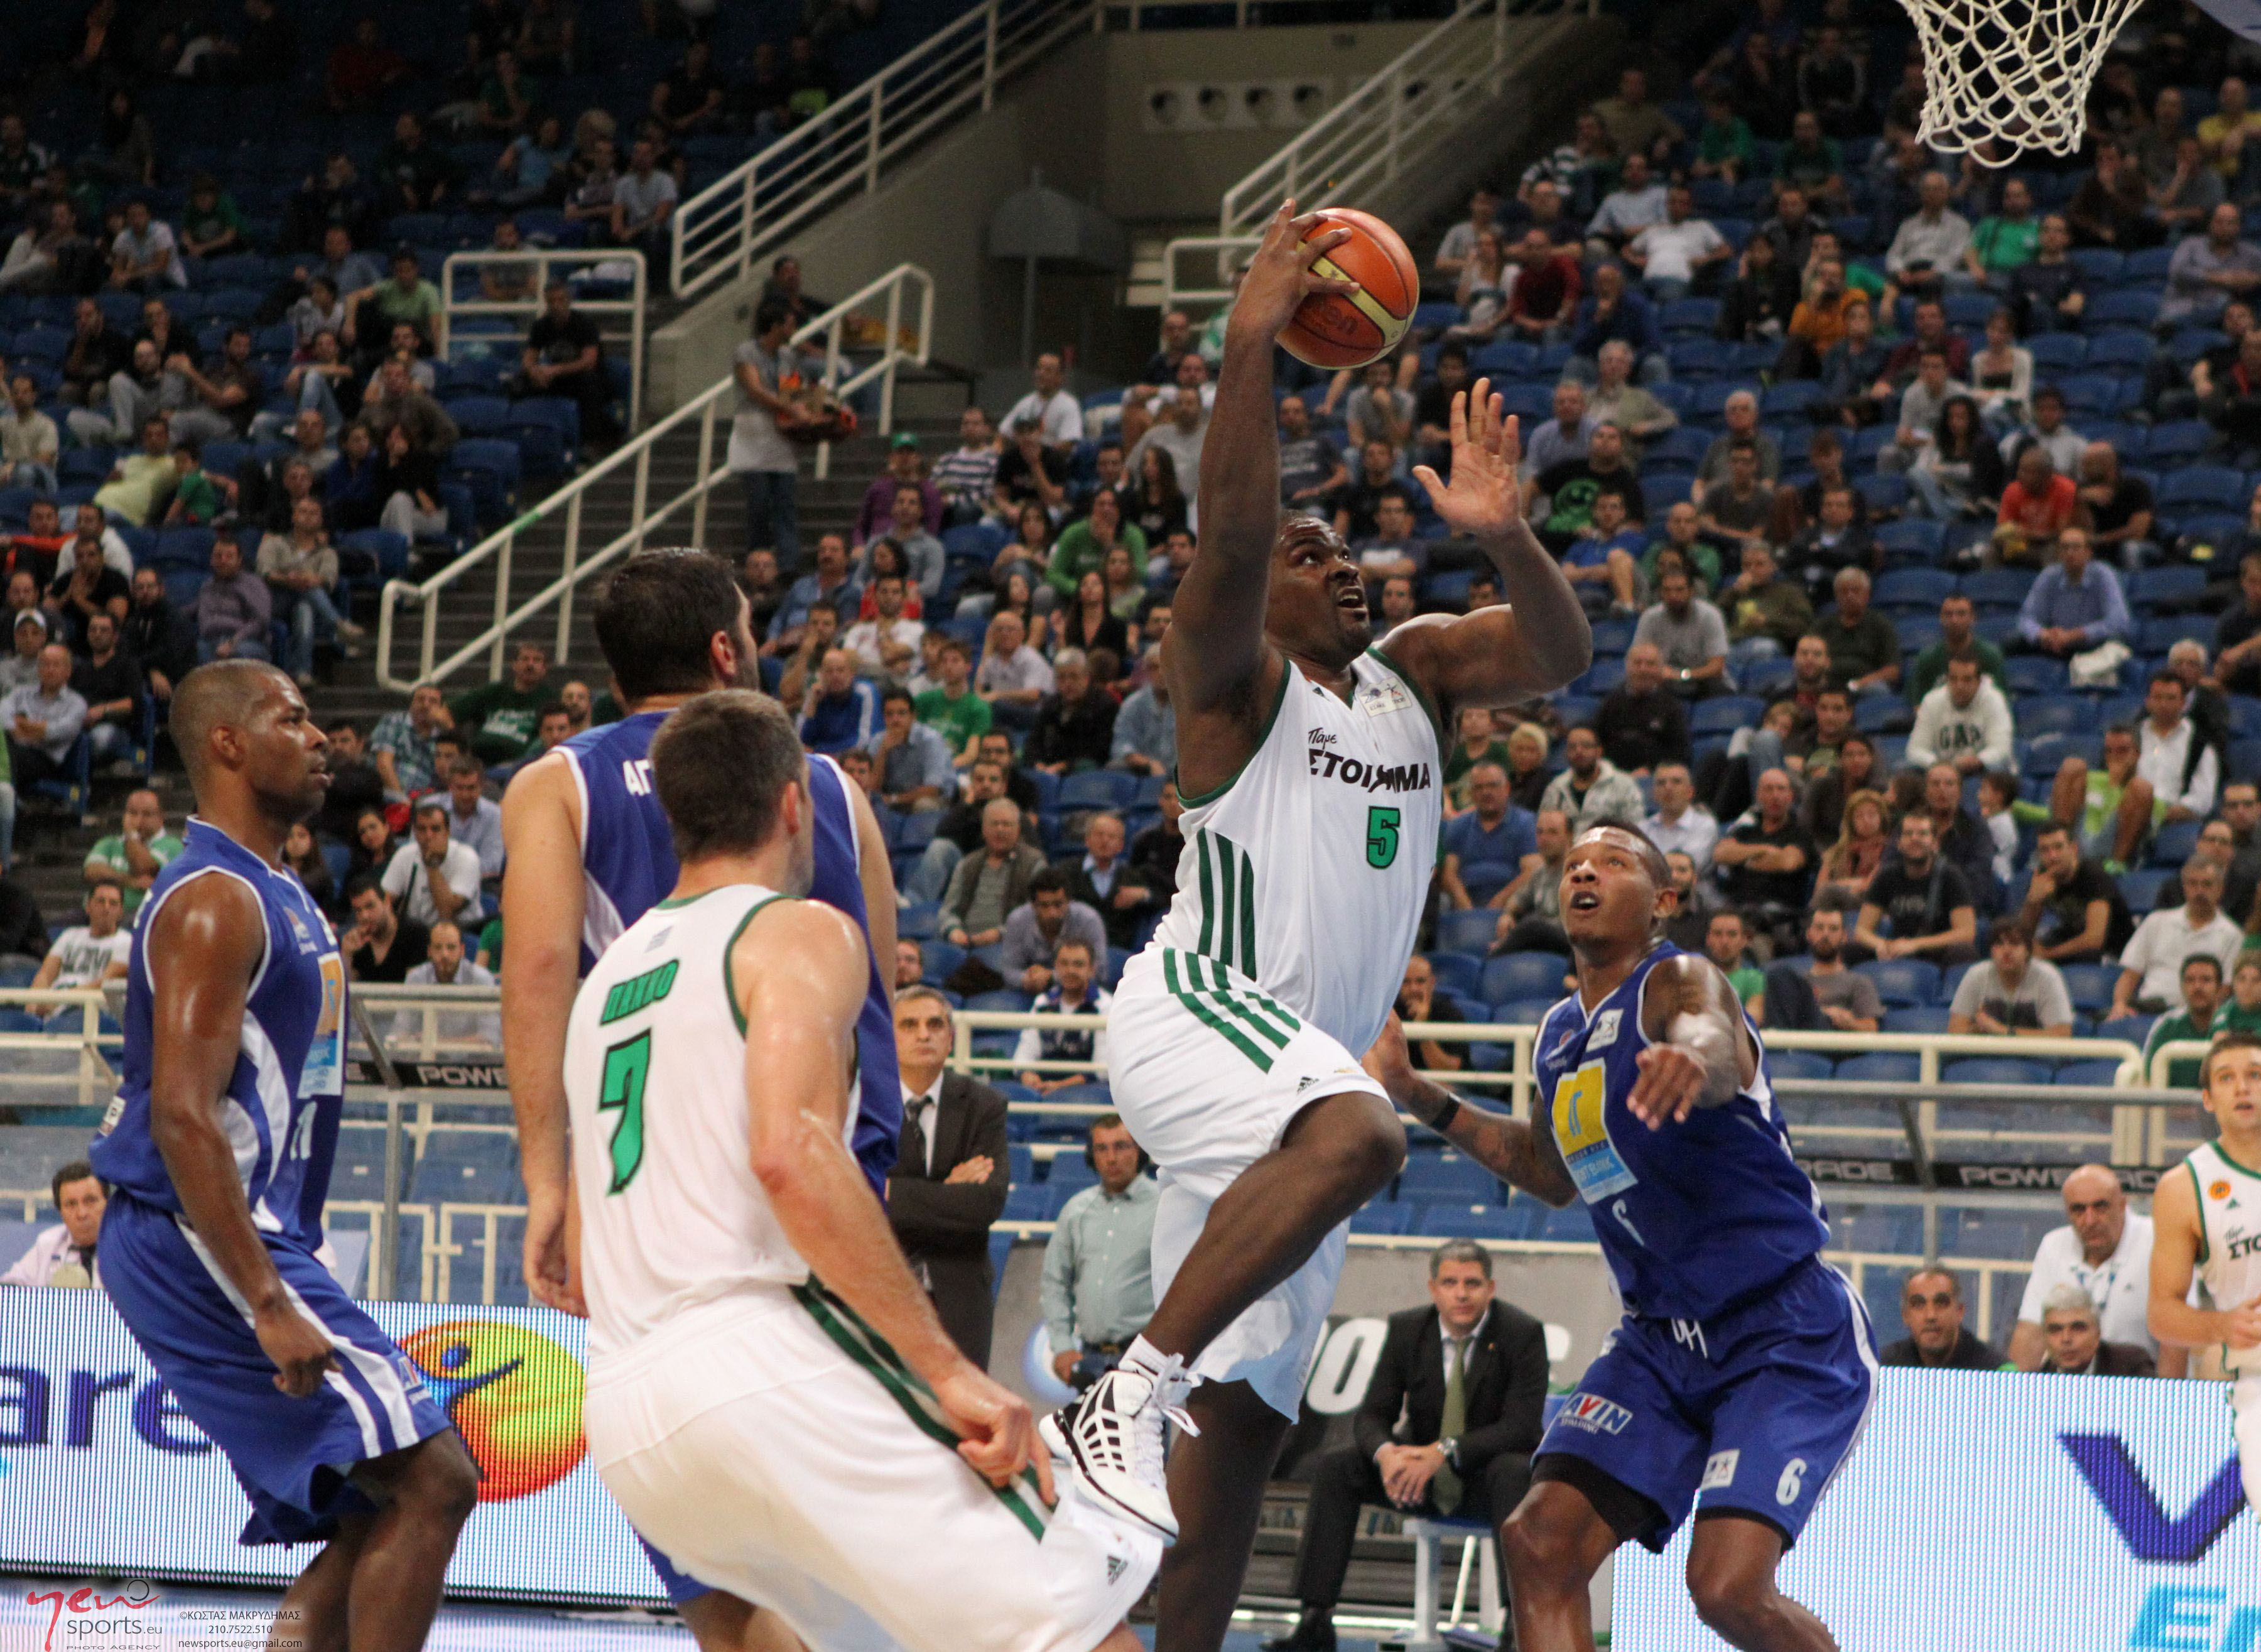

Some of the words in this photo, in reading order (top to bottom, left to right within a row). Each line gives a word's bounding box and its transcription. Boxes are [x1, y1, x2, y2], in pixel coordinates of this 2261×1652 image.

[1365, 805, 1401, 870] 5
[597, 1026, 652, 1195] 7
[1562, 1394, 1630, 1432] AVIN
[1776, 1457, 1807, 1506] 6
